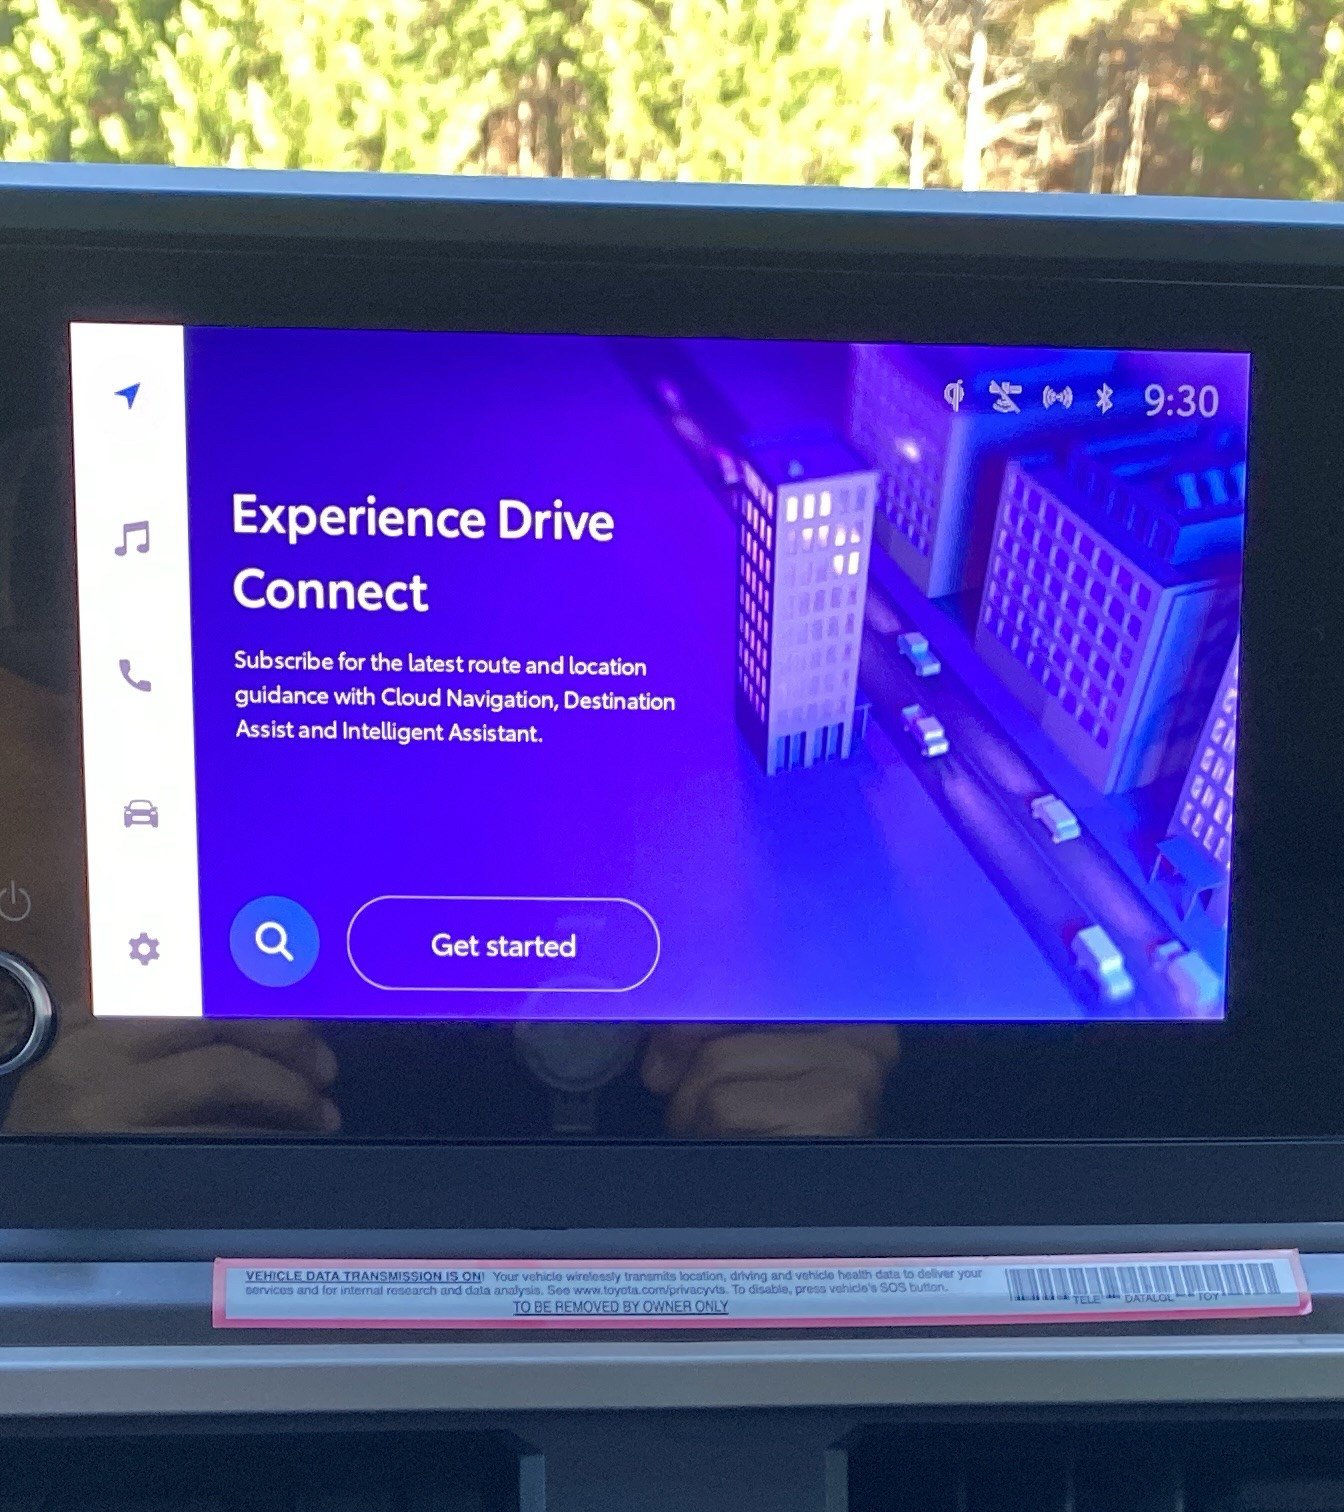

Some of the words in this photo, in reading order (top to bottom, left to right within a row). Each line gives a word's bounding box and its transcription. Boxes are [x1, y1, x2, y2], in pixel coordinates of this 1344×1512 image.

[1144, 383, 1219, 418] 9:30
[232, 493, 487, 545] Experience
[499, 498, 615, 542] Drive
[233, 567, 429, 612] Connect
[234, 650, 334, 671] Subscribe
[338, 651, 366, 672] for
[370, 652, 403, 673] the
[408, 653, 464, 673] latest
[468, 655, 521, 675] route
[525, 655, 564, 675] and
[568, 655, 647, 677] location
[234, 685, 330, 708] guidance
[334, 686, 376, 706] with
[381, 687, 441, 707] Cloud
[446, 689, 559, 712] Navigation,
[563, 691, 676, 711] Destination
[235, 719, 294, 739] Assist
[298, 720, 337, 739] and
[342, 720, 444, 746] Intelligent
[448, 722, 543, 743] Assistant.
[431, 932, 480, 957] Get
[485, 932, 577, 958] started
[245, 1270, 303, 1282] VEHICLE
[307, 1270, 340, 1282] DATA
[344, 1270, 442, 1282] TRANSMISSION
[445, 1271, 459, 1282] IS
[462, 1271, 485, 1282] ON!
[493, 1271, 519, 1282] Your
[522, 1271, 563, 1282] vehicle
[566, 1271, 621, 1284] wirelessly
[624, 1271, 676, 1282] transmits
[679, 1271, 727, 1284] location,
[730, 1270, 767, 1283] driving
[771, 1270, 792, 1281] and
[795, 1269, 834, 1281] vehicle
[837, 1269, 872, 1280] health
[875, 1269, 900, 1280] data
[904, 1269, 914, 1279] to
[918, 1268, 954, 1279] deliver
[957, 1269, 982, 1282] your
[245, 1285, 294, 1296] services
[297, 1285, 319, 1296] and
[322, 1285, 337, 1296] for
[340, 1285, 383, 1296] internal
[386, 1285, 437, 1296] research
[440, 1285, 462, 1296] and
[465, 1285, 490, 1296] data
[494, 1285, 544, 1297] analysis.
[547, 1284, 571, 1295] See
[733, 1284, 746, 1295] To
[749, 1283, 793, 1296] disable,
[795, 1285, 827, 1296] press
[829, 1282, 877, 1294] vehicle's
[880, 1282, 906, 1293] SOS
[909, 1281, 949, 1293] button.
[513, 1300, 532, 1313] TO
[534, 1300, 552, 1313] BE
[555, 1300, 619, 1313] REMOVED
[623, 1300, 639, 1313] BY
[643, 1300, 692, 1313] OWNER
[695, 1300, 730, 1313] ONLY
